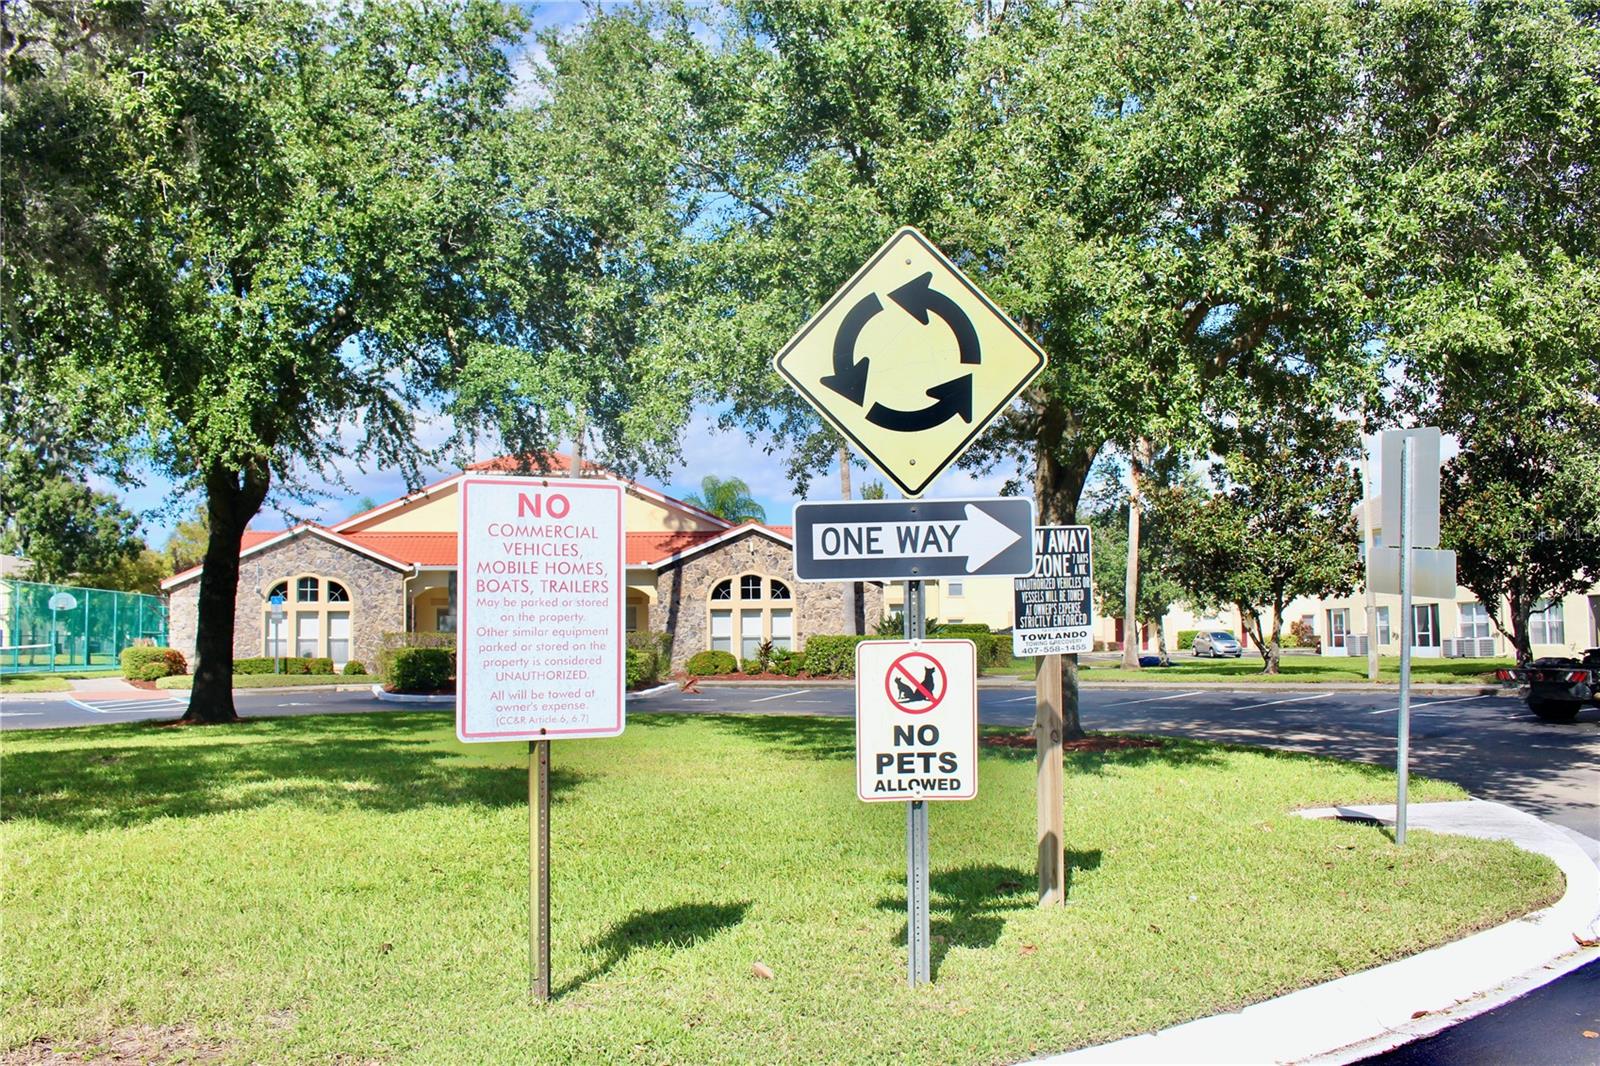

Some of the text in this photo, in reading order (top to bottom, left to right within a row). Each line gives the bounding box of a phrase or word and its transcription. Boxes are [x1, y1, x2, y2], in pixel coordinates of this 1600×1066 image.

[517, 493, 570, 519] NO
[488, 523, 598, 539] COMMERCIAL
[821, 524, 960, 556] ONE WAY
[1048, 530, 1087, 553] AWAY
[503, 542, 583, 559] VEHICLES,
[1072, 553, 1088, 564] 7 DAYS
[476, 561, 609, 578] MOBILE HOMES,
[1035, 554, 1071, 577] ZONE
[1074, 564, 1078, 574] A
[476, 579, 609, 595] BOATS, TRAILERS
[1015, 576, 1090, 590] UNAUTHORIZED VEHICLES OR
[1022, 589, 1084, 603] VESSELS WILL BE TOWED
[476, 598, 499, 609] May
[504, 598, 517, 607] be
[521, 598, 558, 609] parked
[576, 598, 608, 607] stored
[1026, 602, 1081, 615] AT OWNER'S EXPENSE
[519, 613, 535, 621] the
[539, 614, 586, 623] property.
[1020, 613, 1087, 628] STRICTLY ENFORCED
[476, 627, 608, 638] Other similar equipment
[1021, 631, 1087, 641] TOWLANDO
[479, 642, 516, 654] parked
[536, 642, 568, 651] stored
[573, 643, 586, 651] on
[590, 641, 606, 650] the
[483, 658, 529, 668] property
[544, 656, 602, 665] considered
[496, 670, 590, 681] UNAUTHORIZED.
[490, 691, 504, 701] All
[509, 690, 527, 700] will
[531, 690, 544, 699] be
[548, 689, 581, 698] towed
[496, 702, 589, 713] owner's expense.
[529, 715, 556, 723] Article
[561, 716, 569, 724] 6,
[893, 724, 939, 746] NO
[876, 752, 958, 775] PETS
[874, 779, 961, 792] ALLOWED
